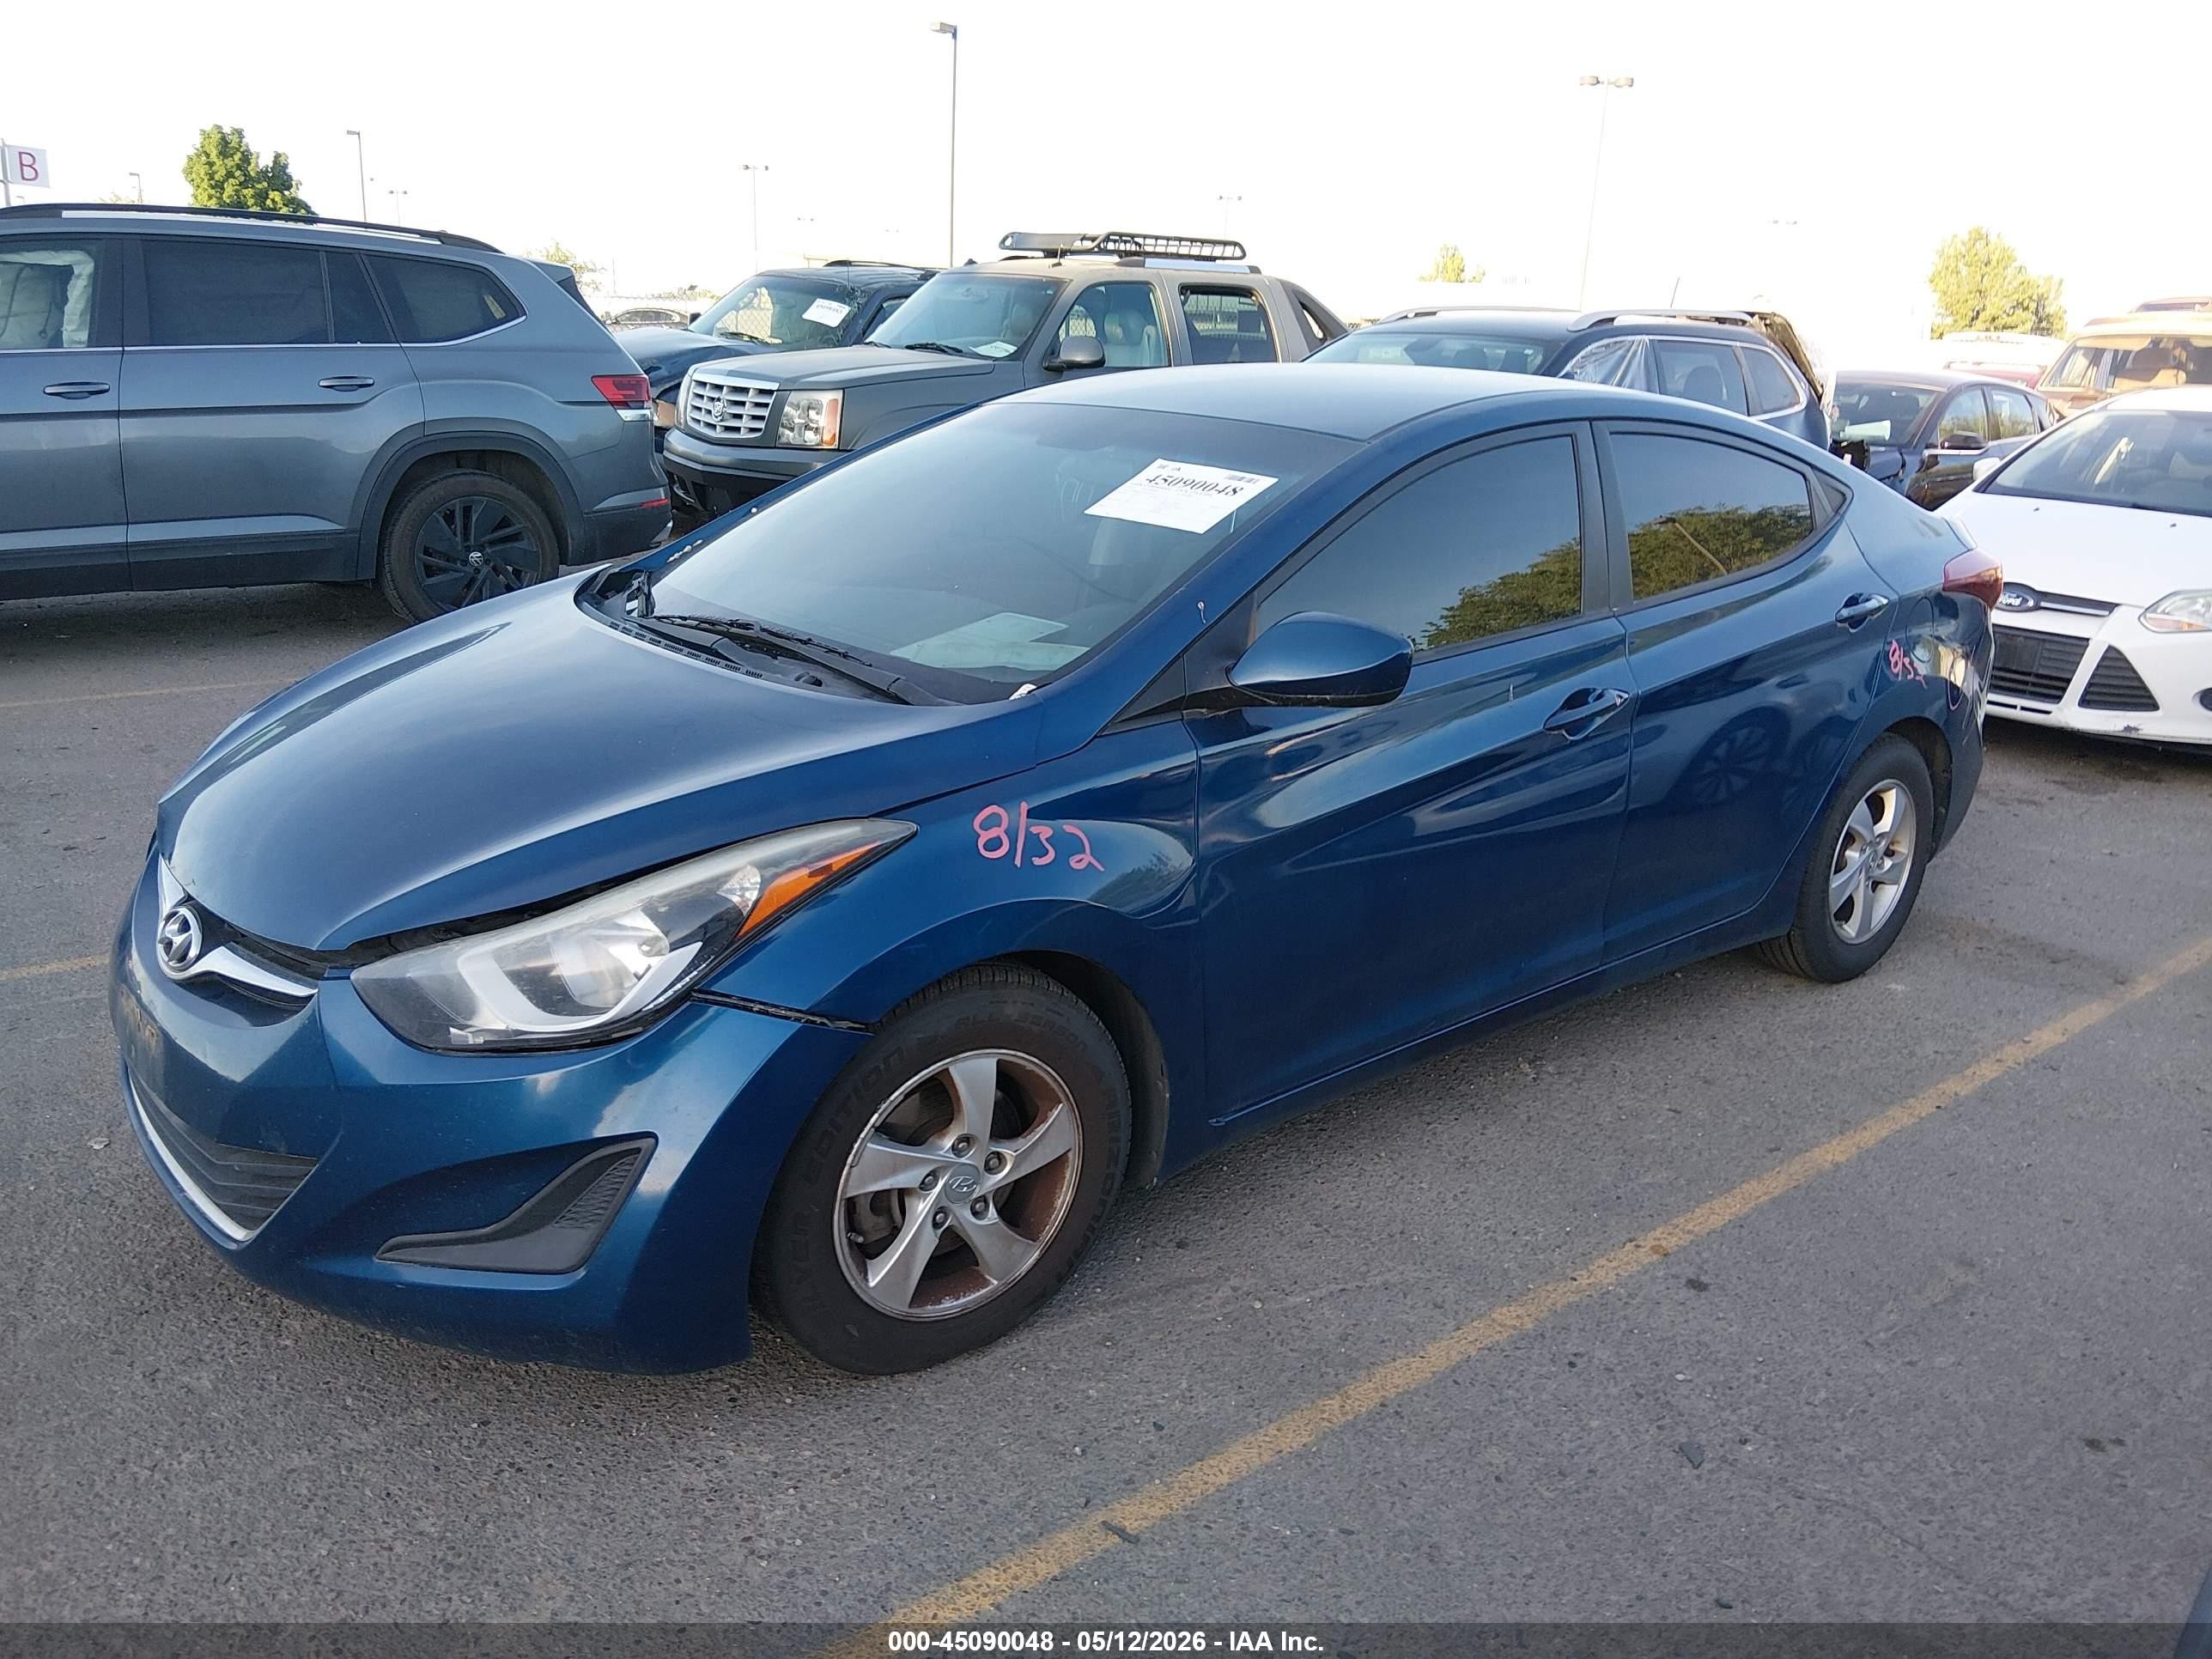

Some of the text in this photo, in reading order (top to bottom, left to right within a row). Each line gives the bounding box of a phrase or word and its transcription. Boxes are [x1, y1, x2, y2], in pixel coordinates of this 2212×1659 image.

[19, 151, 39, 181] B
[1146, 474, 1244, 496] 45090048
[972, 800, 1105, 872] 8/32
